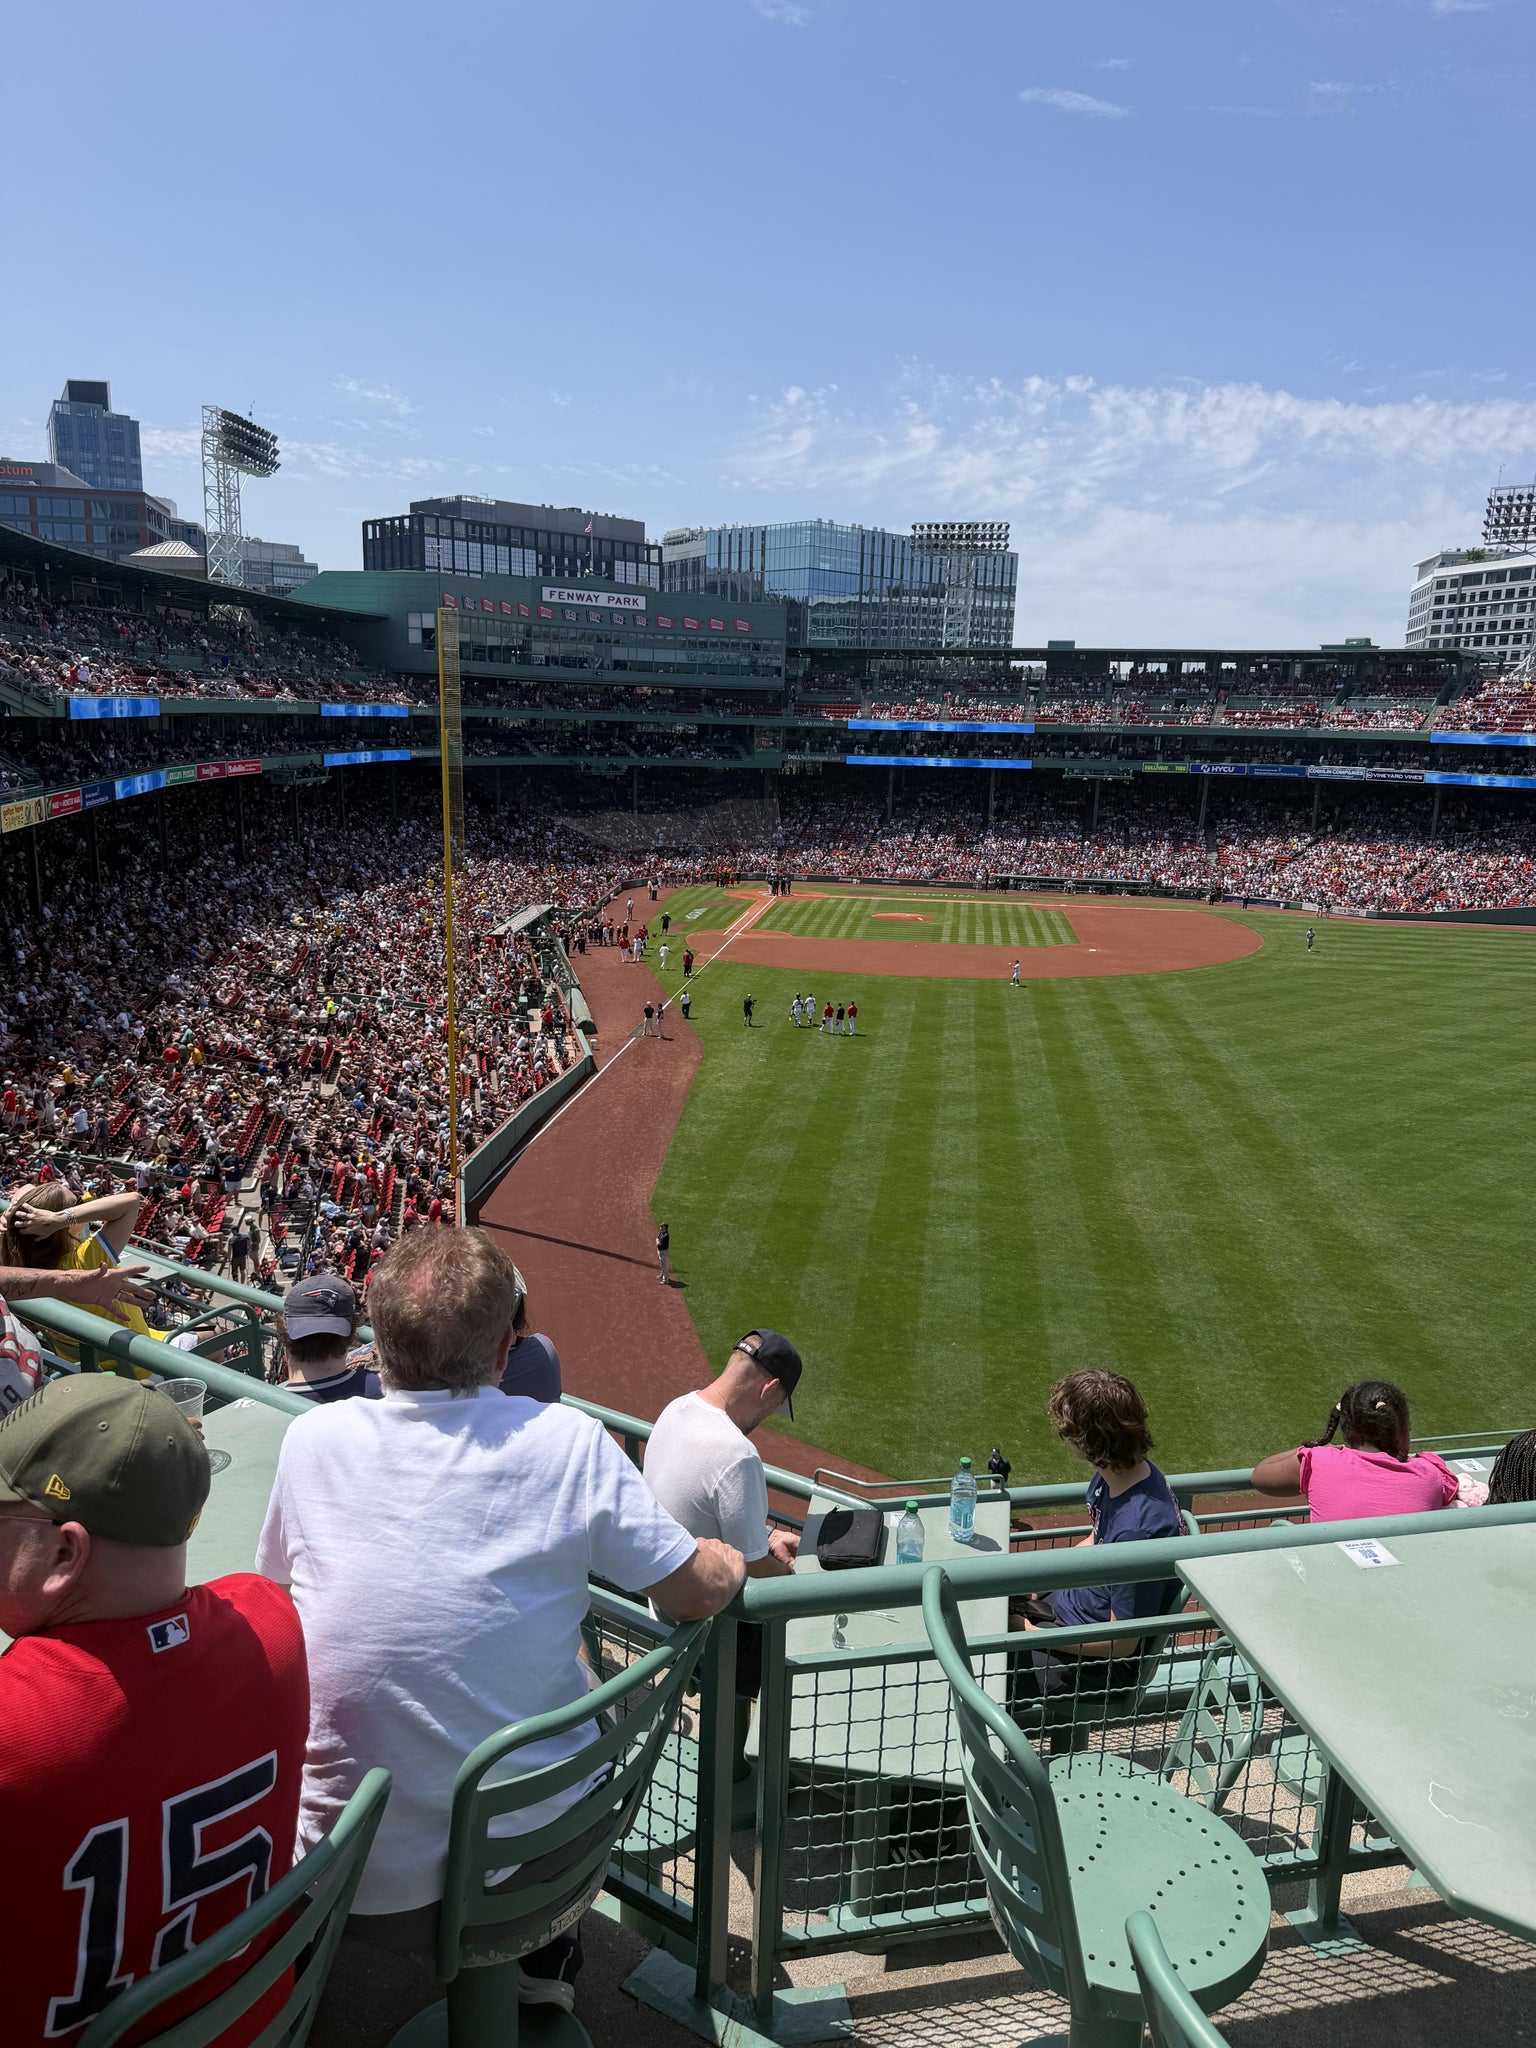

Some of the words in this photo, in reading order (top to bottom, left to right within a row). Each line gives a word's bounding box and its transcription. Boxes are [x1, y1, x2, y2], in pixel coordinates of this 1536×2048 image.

[549, 590, 600, 603] FENWAY
[607, 595, 640, 607] PARK
[45, 1749, 277, 2038] 15
